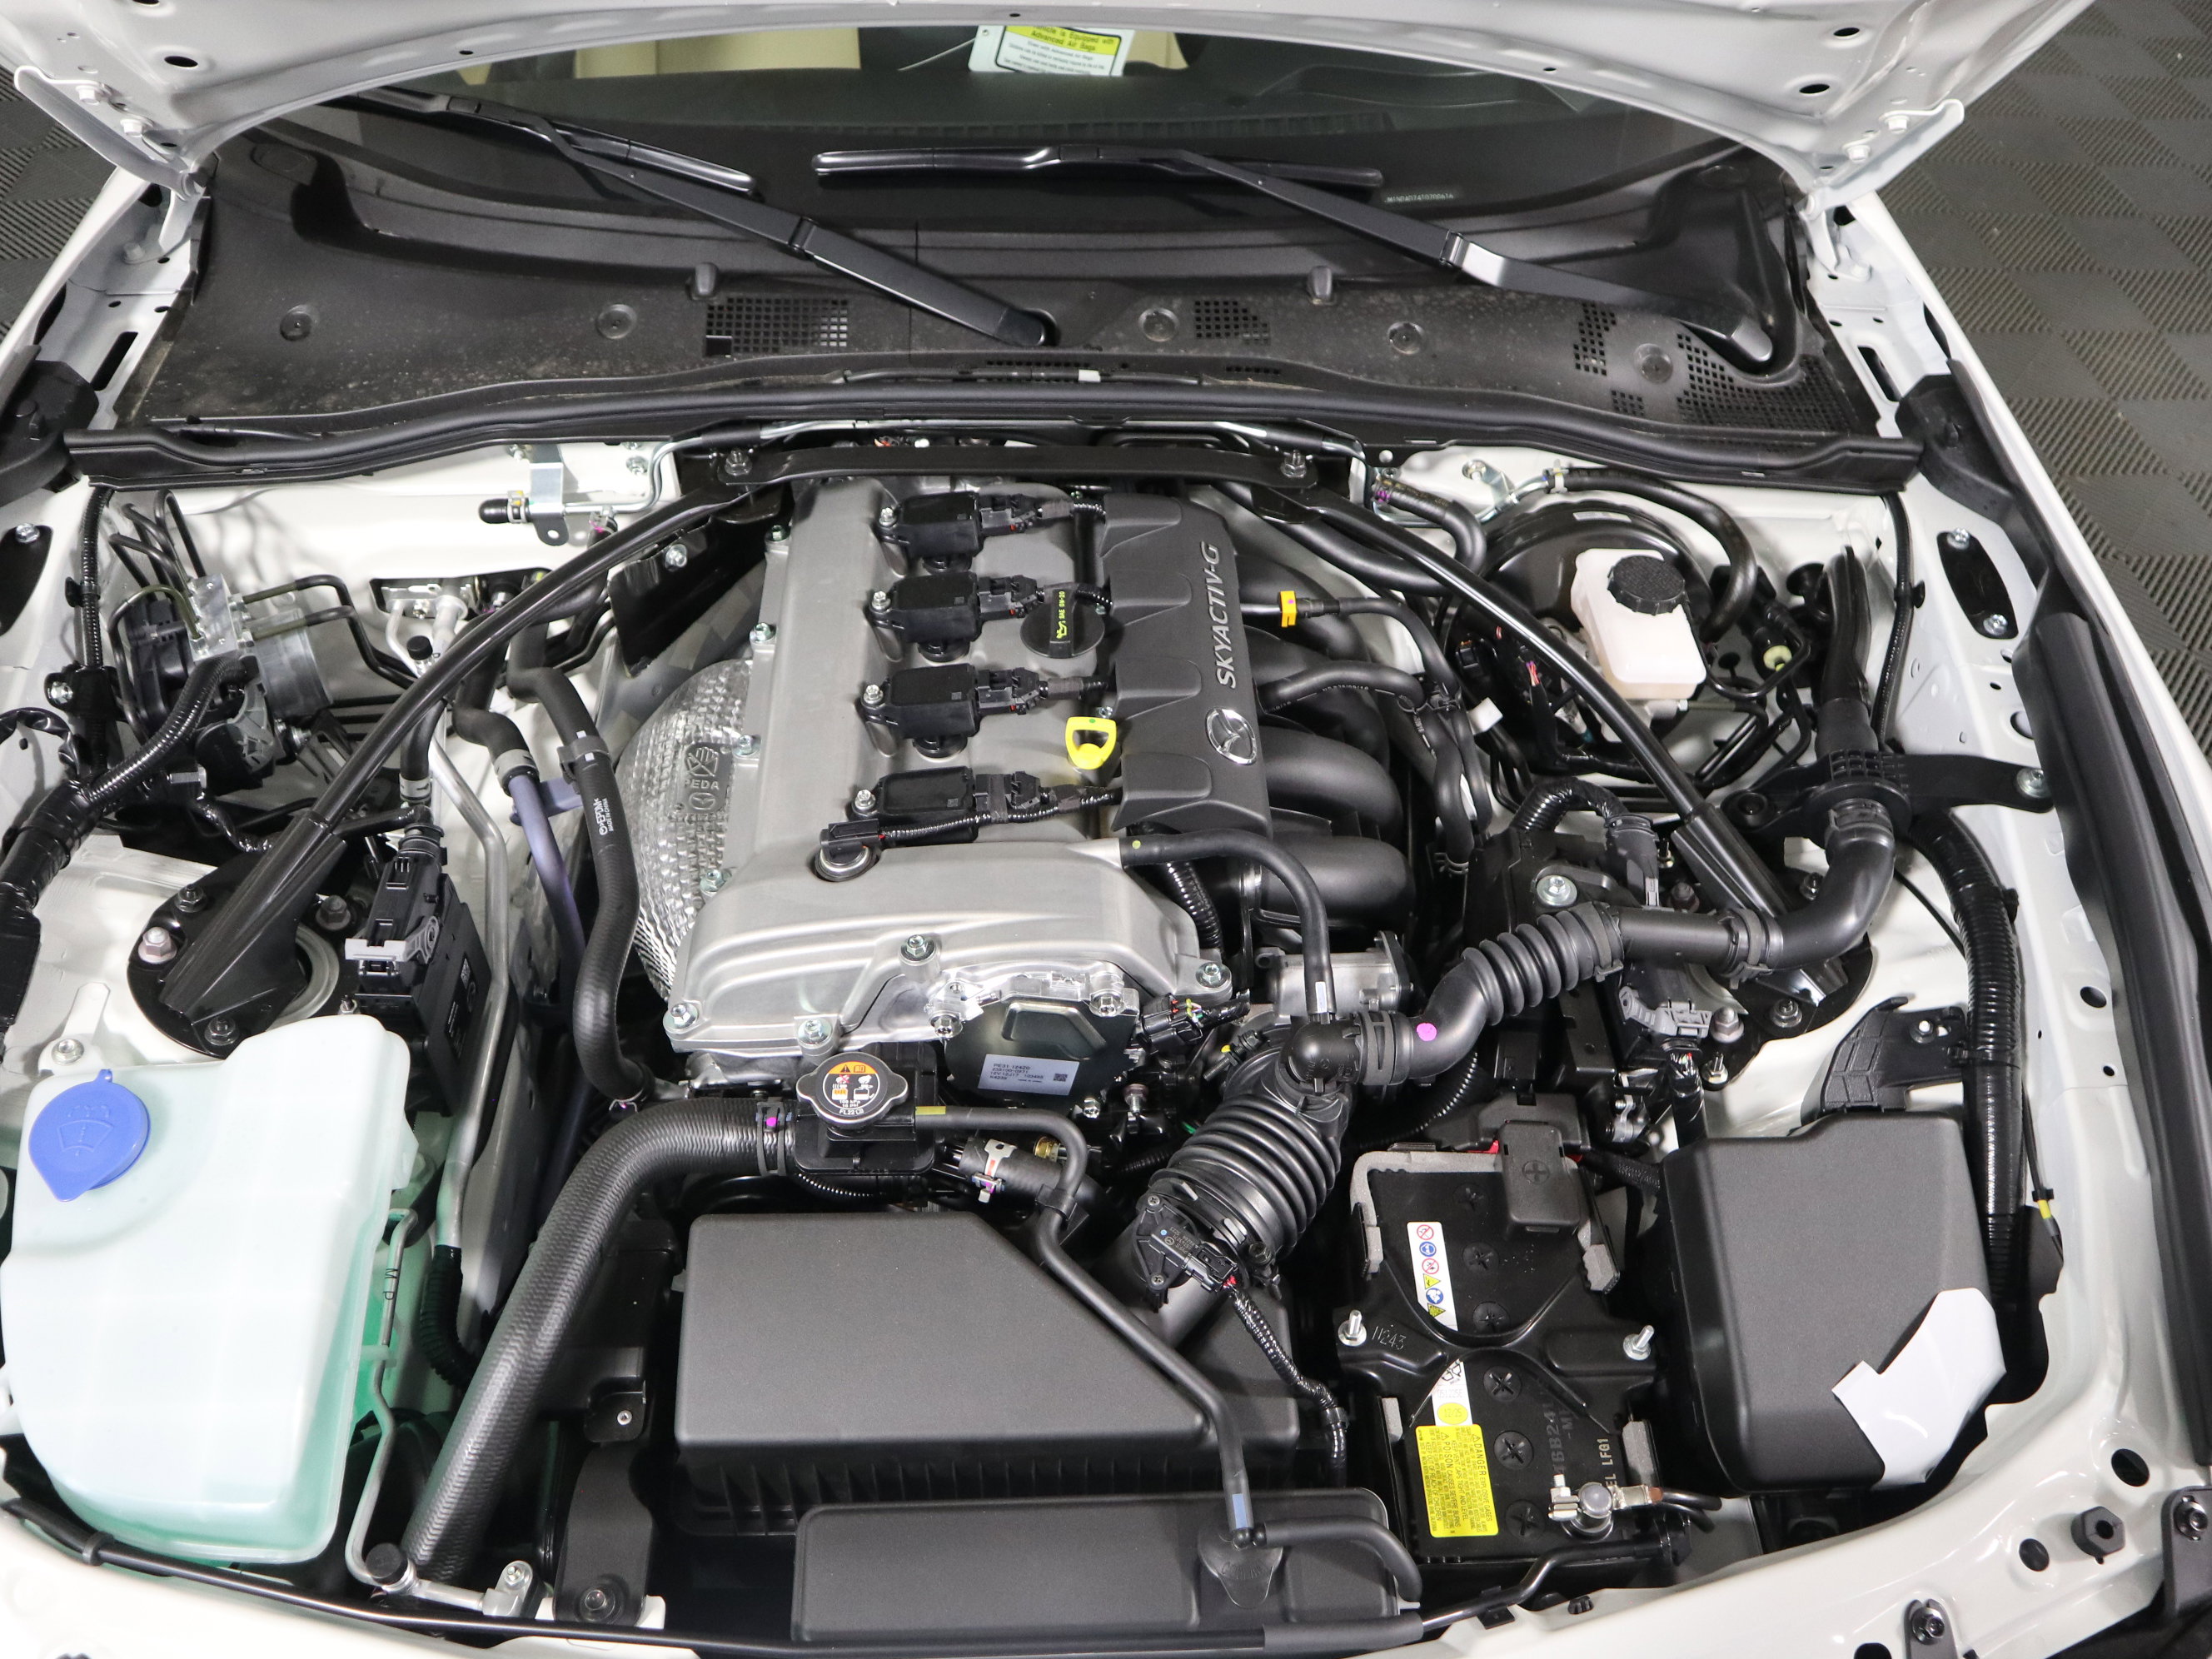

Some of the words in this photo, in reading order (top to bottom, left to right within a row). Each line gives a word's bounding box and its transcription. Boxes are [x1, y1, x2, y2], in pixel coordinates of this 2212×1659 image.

[1031, 30, 1064, 44] Advanced
[1079, 42, 1095, 52] Bags
[1200, 541, 1237, 690] SKYACTIV-G
[1442, 1442, 1454, 1468] POISON
[1473, 1443, 1487, 1475] DANGER
[1597, 1438, 1613, 1466] LFG1
[1428, 1472, 1437, 1489] REACH
[1446, 1469, 1455, 1488] CAUSES
[1452, 1453, 1460, 1465] VENT
[1460, 1506, 1469, 1521] LEVEL
[1479, 1477, 1489, 1503] EXPLOSIVE
[1432, 1497, 1442, 1521] CHILDREN
[1449, 1490, 1458, 1508] SEVERE
[1452, 1510, 1461, 1527] BURNS
[1483, 1505, 1492, 1521] GASES
